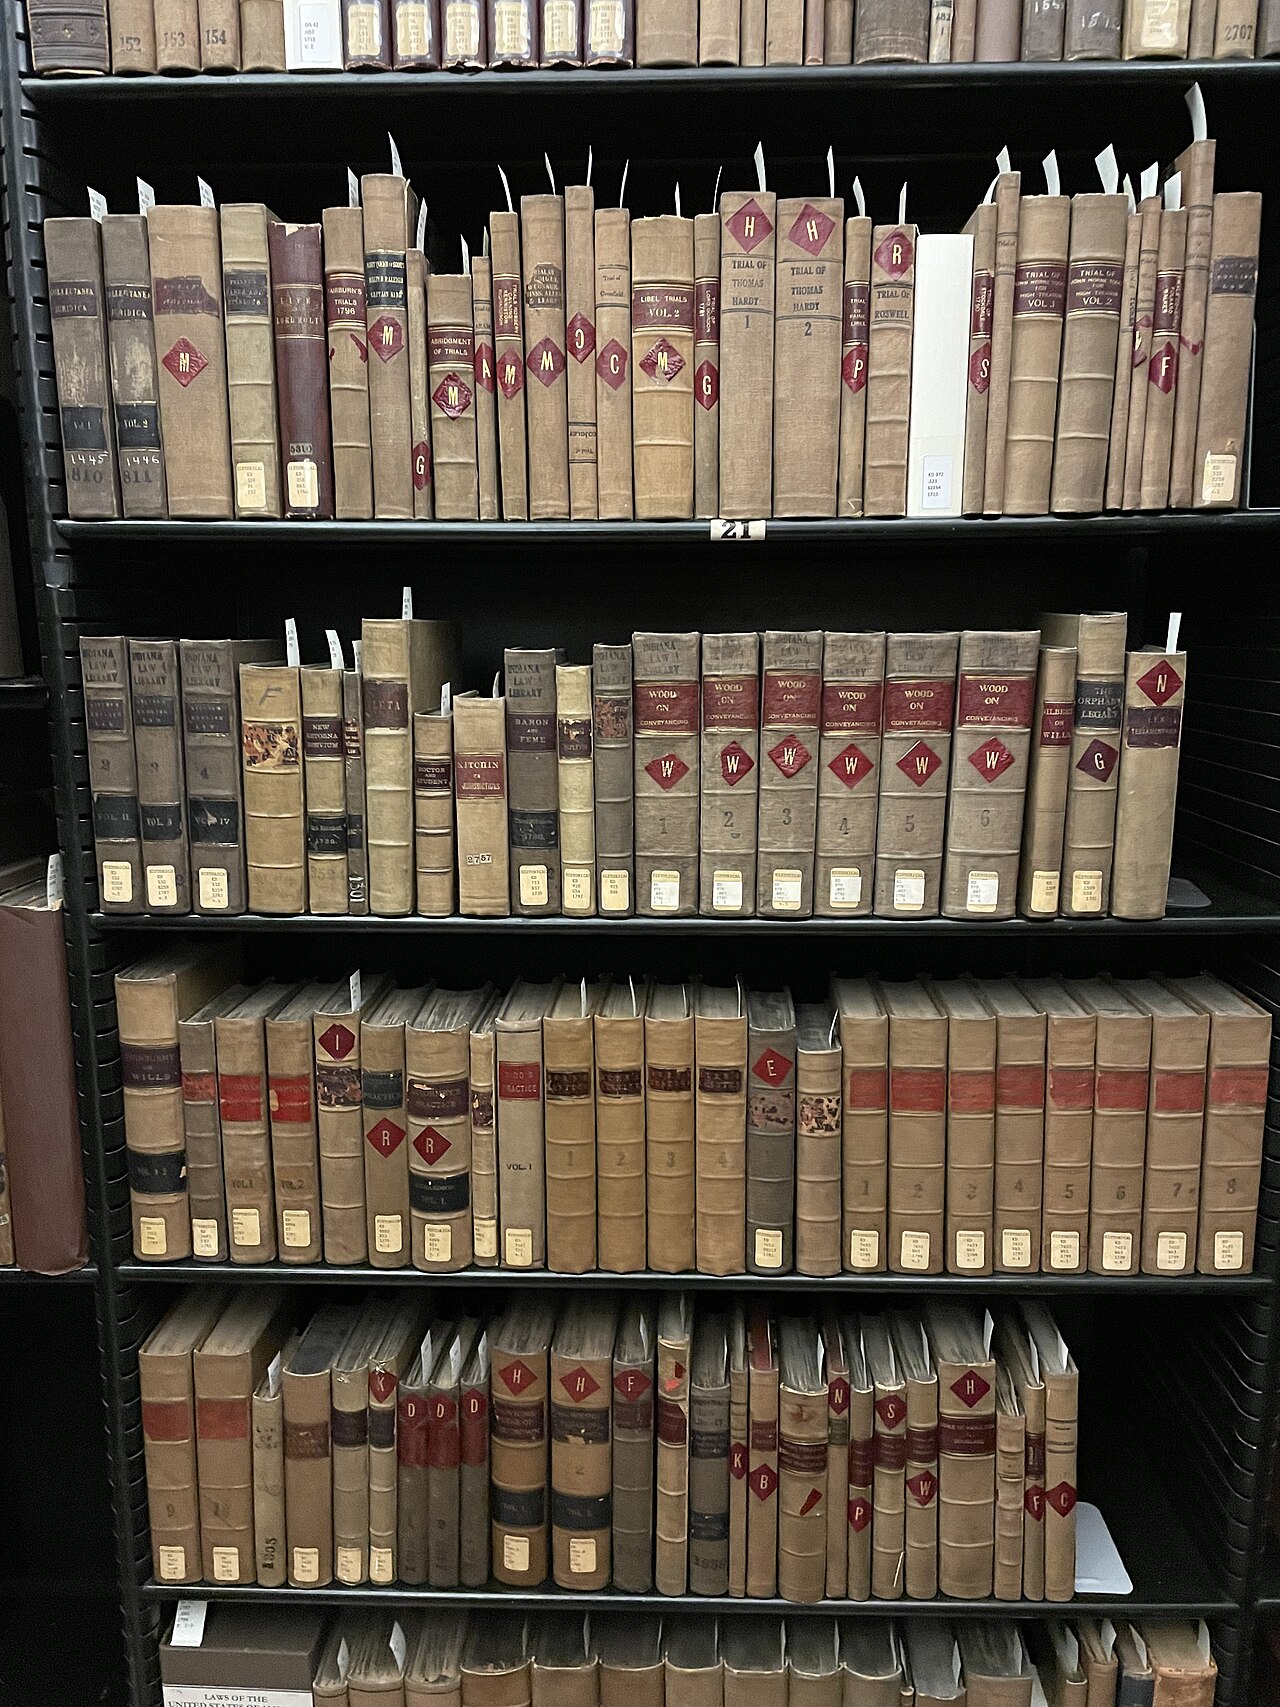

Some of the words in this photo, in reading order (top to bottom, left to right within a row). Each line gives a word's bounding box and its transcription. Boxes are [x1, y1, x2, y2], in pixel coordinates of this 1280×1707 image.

[163, 31, 185, 48] 153
[205, 29, 226, 45] 154
[1225, 24, 1253, 42] 2707
[120, 36, 142, 52] 152
[744, 216, 755, 237] H
[806, 220, 819, 241] H
[892, 244, 902, 265] R
[732, 260, 754, 269] TRIAL
[757, 260, 767, 268] OF
[790, 267, 813, 276] TRIAL
[815, 266, 826, 275] OF
[732, 279, 764, 287] THOMAS
[791, 286, 824, 295] THOMAS
[640, 295, 659, 303] LIBEL
[664, 295, 688, 303] TRIALS
[732, 297, 759, 305] HARDY
[876, 290, 899, 299] TRIAL
[900, 290, 910, 298] OF
[1082, 297, 1101, 305] VOL
[337, 307, 355, 315] 1796
[793, 302, 820, 312] HARDY
[1027, 299, 1045, 308] VOL
[674, 309, 680, 318] 2
[874, 310, 909, 319] ROSWELL
[744, 315, 750, 329] 1
[804, 322, 812, 336] 2
[382, 325, 393, 345] M
[575, 328, 584, 349] C
[482, 359, 491, 379] A
[541, 352, 553, 371] M
[610, 354, 620, 374] C
[980, 359, 990, 378] S
[1161, 357, 1169, 377] F
[505, 365, 515, 385] M
[853, 360, 863, 379] P
[703, 375, 711, 395] G
[448, 387, 458, 406] M
[70, 450, 108, 466] 1445
[126, 455, 160, 466] 1446
[415, 455, 425, 475] G
[72, 467, 104, 483] 810
[123, 470, 153, 483] 811
[720, 520, 751, 539] 21
[714, 684, 743, 692] WOOD
[777, 680, 806, 688] WOOD
[979, 684, 1008, 693] WOOD
[1094, 687, 1113, 695] THE
[1156, 675, 1167, 693] N
[649, 690, 677, 699] WOOD
[721, 696, 734, 704] ON
[783, 694, 796, 702] ON
[838, 691, 867, 700] WOOD
[904, 690, 934, 698] WOOD
[984, 697, 999, 705] ON
[656, 704, 669, 712] ON
[843, 704, 857, 712] ON
[910, 702, 924, 710] ON
[515, 718, 549, 726] BARON
[784, 747, 797, 765] W
[986, 751, 1000, 770] W
[1095, 752, 1105, 770] G
[457, 761, 499, 770] KITCHIN
[661, 760, 674, 777] W
[727, 755, 739, 774] W
[845, 757, 857, 775] W
[916, 756, 929, 775] W
[723, 811, 734, 828] 2
[782, 808, 792, 825] 3
[904, 814, 915, 832] 5
[980, 808, 991, 827] 6
[660, 818, 669, 834] 1
[839, 817, 850, 835] 4
[467, 854, 492, 864] 2757
[767, 1060, 776, 1077] E
[131, 1072, 171, 1081] WILLS
[382, 1130, 391, 1146] R
[425, 1137, 434, 1154] R
[567, 1151, 574, 1166] 1
[616, 1152, 626, 1166] 2
[666, 1151, 676, 1168] 3
[862, 1180, 870, 1195] 1
[914, 1184, 923, 1198] 2
[1014, 1178, 1024, 1193] 4
[1064, 1183, 1074, 1199] 5
[1116, 1186, 1126, 1200] 6
[1172, 1183, 1182, 1197] 7
[1226, 1178, 1237, 1195] 8
[513, 1369, 521, 1384] H
[577, 1377, 585, 1392] H
[627, 1377, 635, 1392] F
[966, 1380, 975, 1395] H
[835, 1389, 843, 1404] N
[408, 1403, 415, 1417] D
[437, 1404, 444, 1418] D
[471, 1399, 478, 1414] D
[887, 1404, 895, 1418] S
[734, 1453, 742, 1468] K
[760, 1474, 768, 1489] B
[920, 1480, 931, 1496] W
[1033, 1495, 1040, 1511] F
[855, 1506, 863, 1521] P
